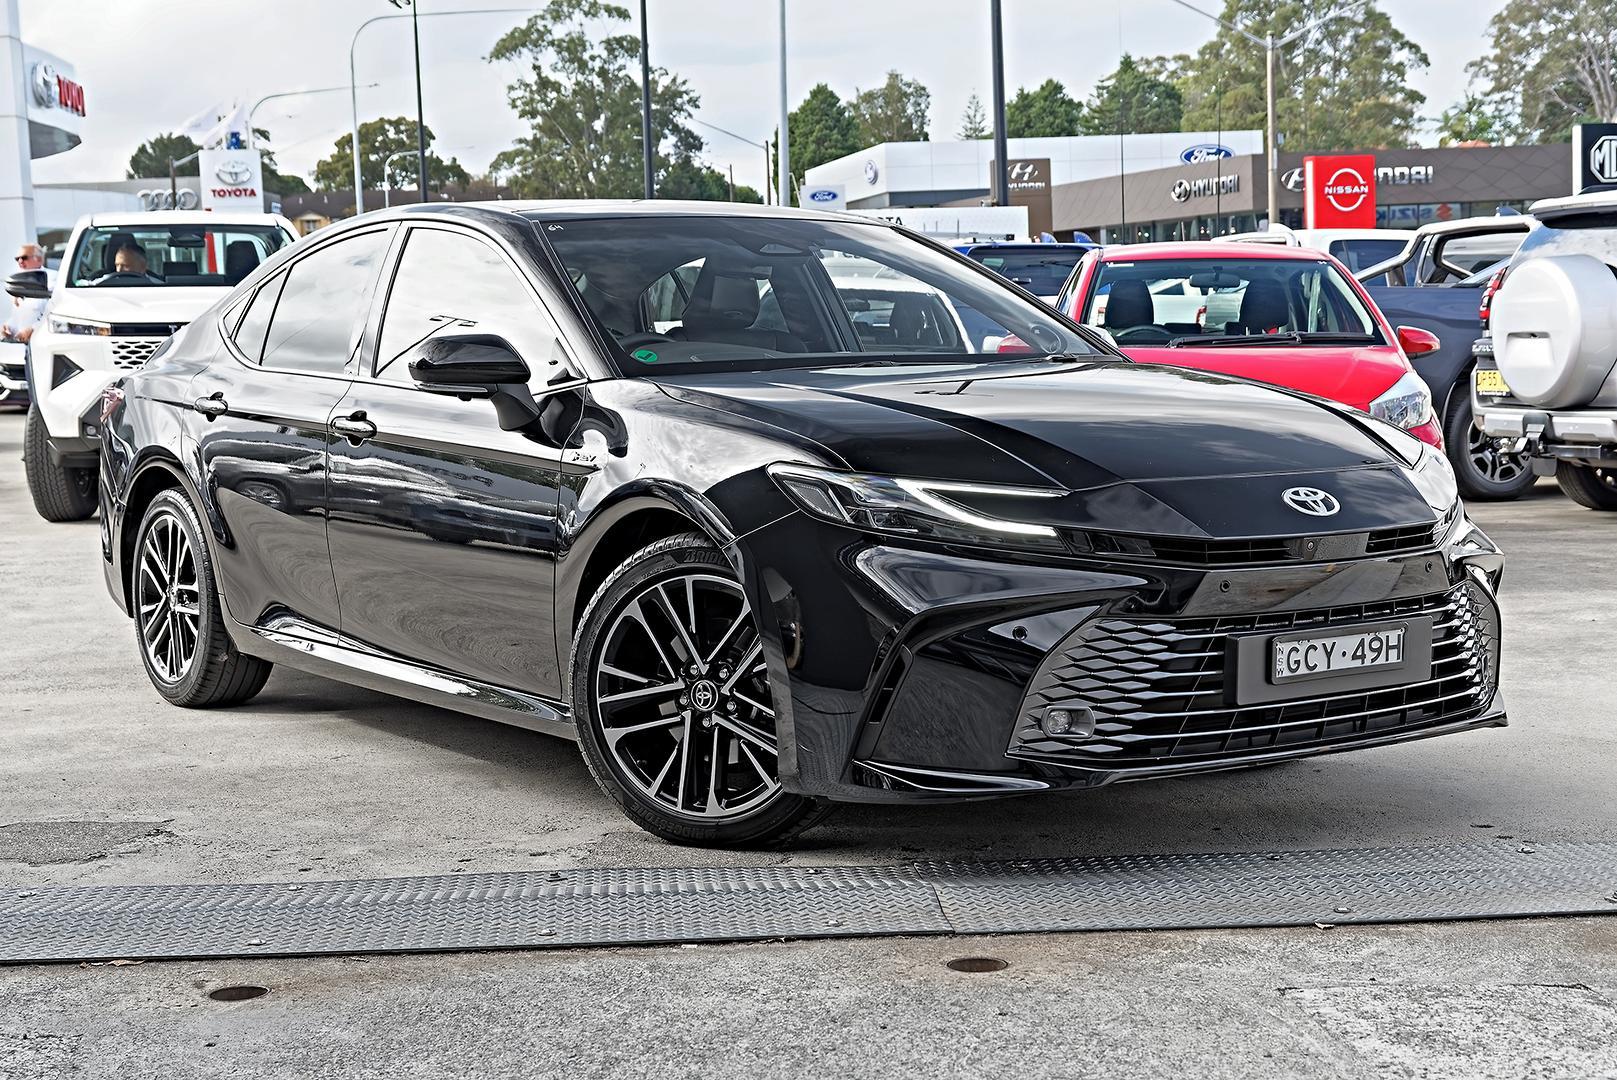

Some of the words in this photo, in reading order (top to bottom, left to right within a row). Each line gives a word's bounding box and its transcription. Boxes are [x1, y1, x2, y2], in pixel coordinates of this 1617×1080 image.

[1190, 148, 1226, 164] Ford
[1374, 166, 1433, 185] NDAI
[1007, 182, 1045, 191] YUNDAI
[1191, 174, 1240, 198] HYUNDAI
[1324, 185, 1369, 194] NISSAN
[211, 188, 256, 198] TOYOTA
[814, 192, 834, 201] Ford
